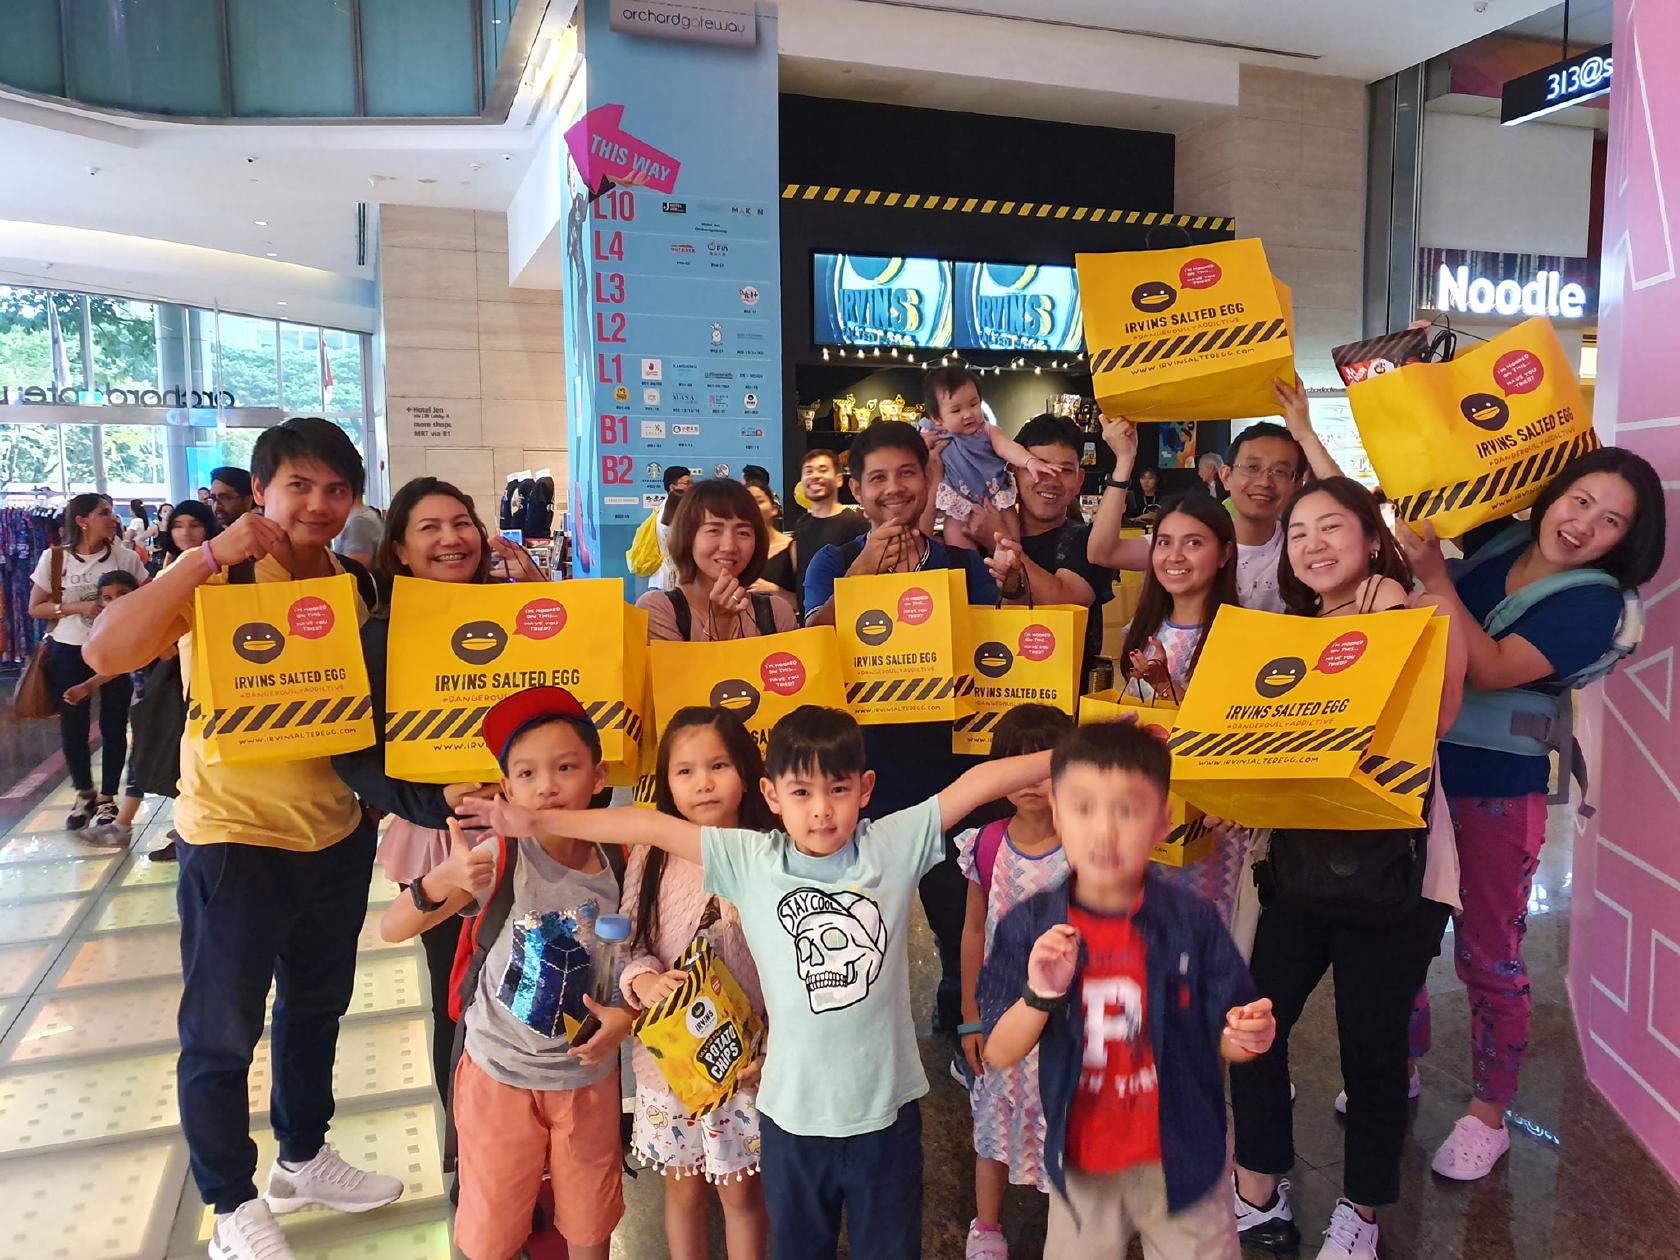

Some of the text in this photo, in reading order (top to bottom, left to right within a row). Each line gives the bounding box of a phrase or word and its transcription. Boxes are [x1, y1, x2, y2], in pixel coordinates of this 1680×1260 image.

[622, 8, 745, 35] orchardgateway
[591, 134, 672, 181] THIS WAY
[593, 191, 635, 222] L10
[594, 231, 625, 262] L4
[595, 272, 625, 304] L3
[1438, 264, 1586, 318] Noodle
[841, 288, 922, 332] IRVINS
[979, 294, 1056, 336] IRVINS
[1125, 302, 1245, 333] IRVINS SALTED EGG
[597, 312, 627, 344] L2
[598, 353, 622, 384] L1
[600, 415, 628, 444] B1
[1476, 406, 1574, 459] IRVINS SALTED EGG
[602, 455, 634, 485] B2
[854, 651, 937, 668] IRVINS SALTED EGG
[235, 668, 346, 689] IRVINS SALTED EGG
[435, 669, 581, 692] IRVINS SALTED EGG
[1004, 687, 1037, 699] SALTED
[1039, 688, 1057, 700] EGG
[1225, 698, 1350, 720] IRVINS SALTED EGG
[780, 893, 842, 932] STAY COOL
[695, 1009, 714, 1032] IRVINS
[705, 1024, 737, 1064] POTATO
[710, 1042, 739, 1080] CHIPS
